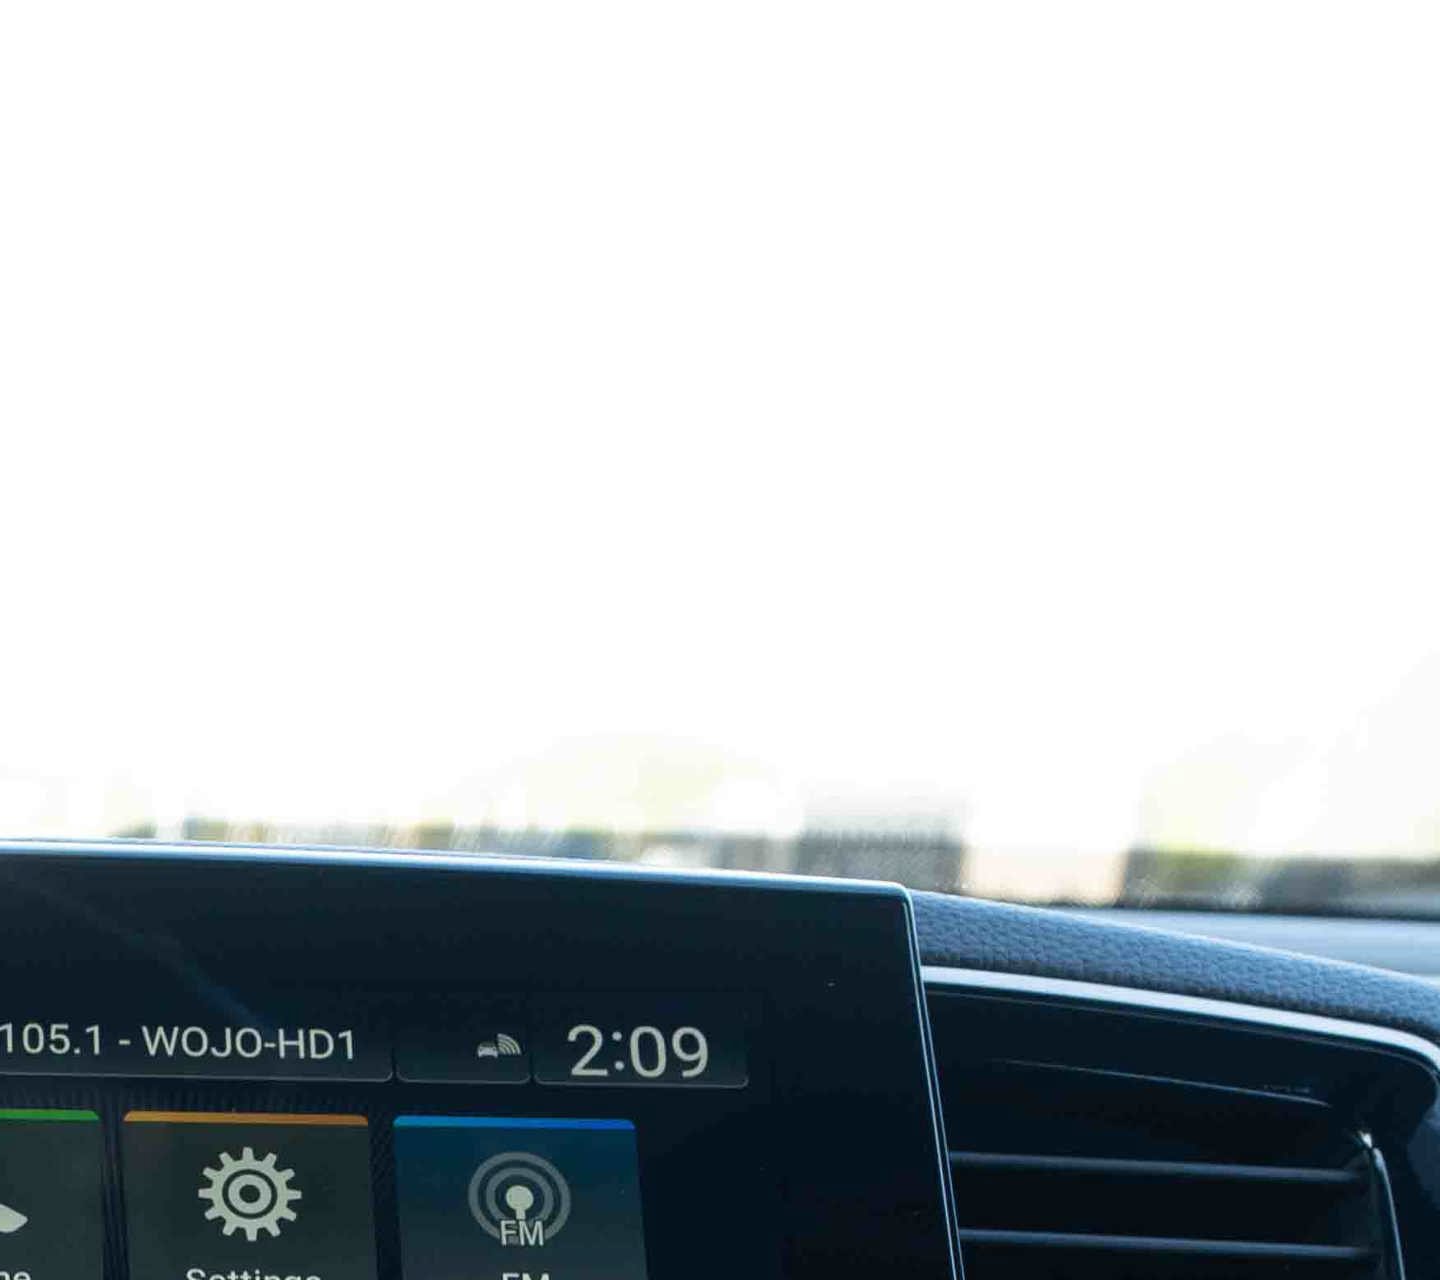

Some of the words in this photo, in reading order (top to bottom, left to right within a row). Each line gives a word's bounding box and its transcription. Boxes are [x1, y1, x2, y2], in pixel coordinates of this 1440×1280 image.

[142, 1027, 356, 1061] WOJO-HD1
[568, 1025, 709, 1078] 2:09
[500, 1220, 544, 1247] FM
